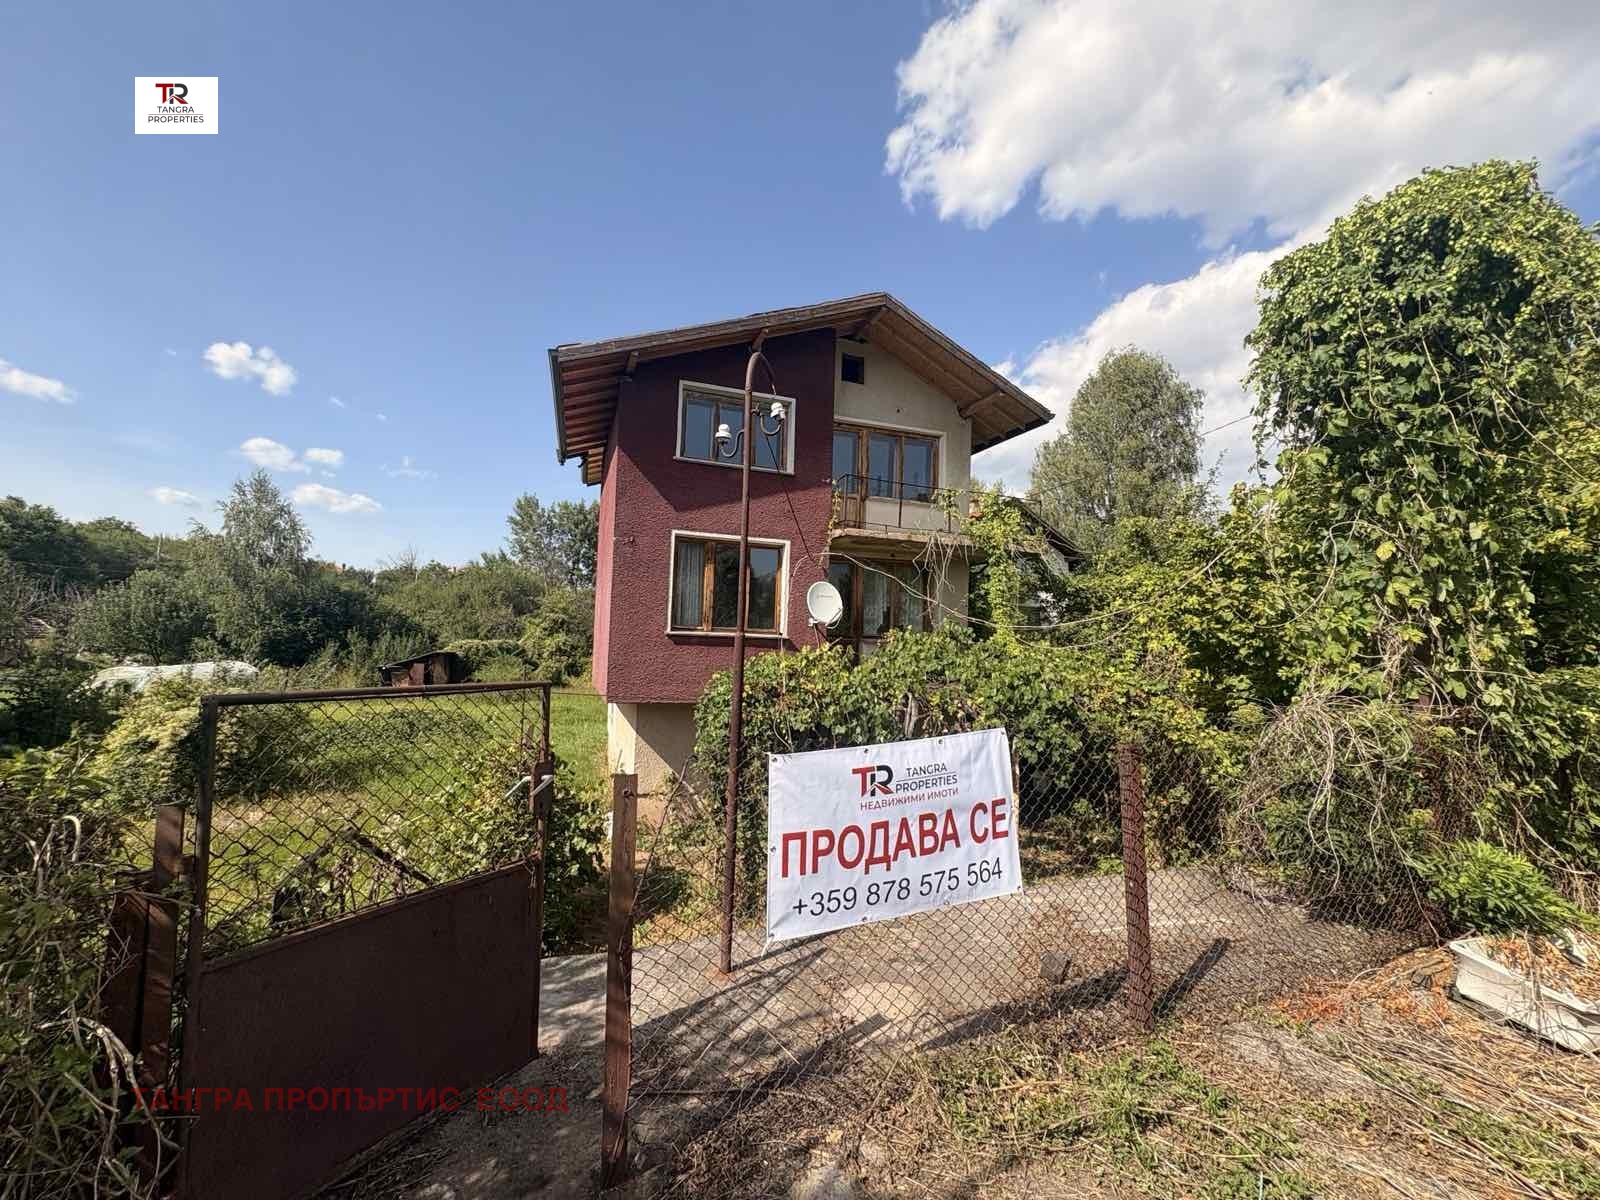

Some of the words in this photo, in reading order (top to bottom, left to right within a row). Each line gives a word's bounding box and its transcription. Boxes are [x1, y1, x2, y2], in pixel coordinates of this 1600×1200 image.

[906, 762, 947, 777] TANGRA
[895, 774, 958, 794] PROPERTIES
[860, 794, 925, 810] НЕДВИЖИМИ
[927, 787, 959, 801] ИМОТИ
[781, 807, 961, 878] ПРОДАВА
[970, 798, 1009, 845] СЕ
[792, 886, 857, 916] +359
[866, 877, 911, 906] 878
[919, 867, 960, 897] 575
[967, 856, 1002, 886] 564
